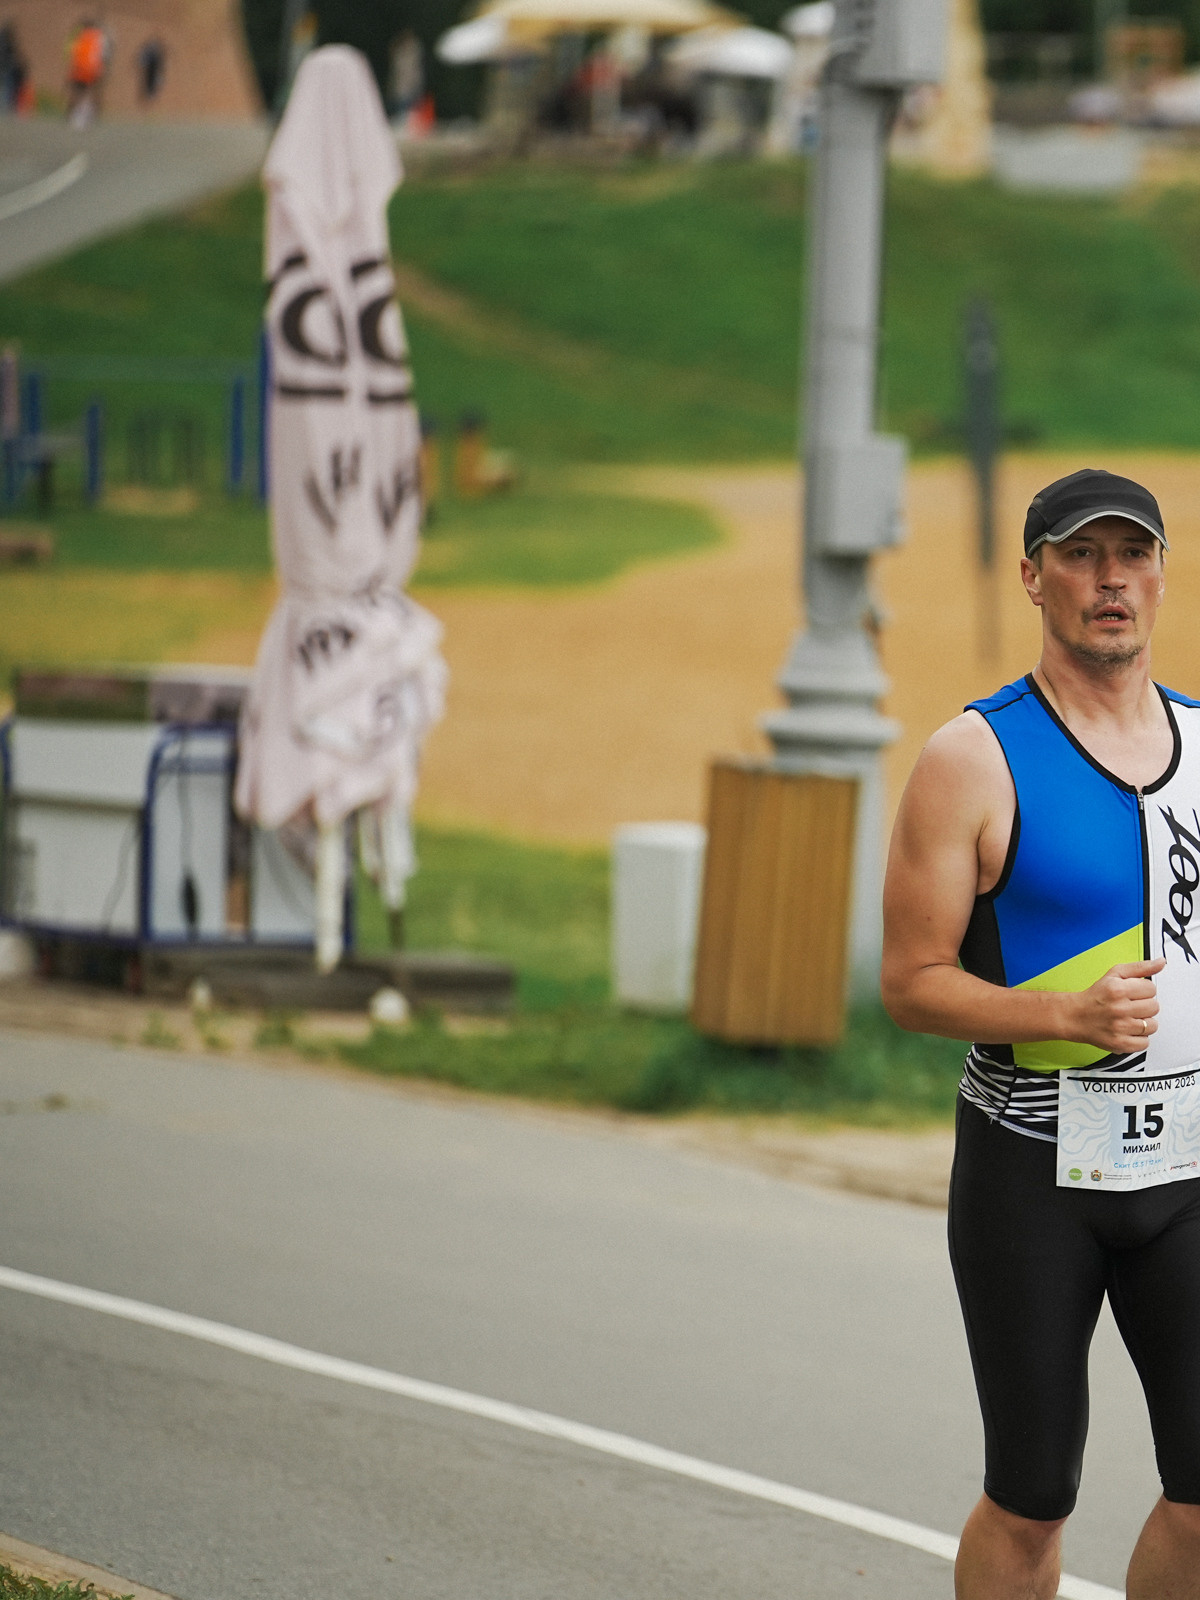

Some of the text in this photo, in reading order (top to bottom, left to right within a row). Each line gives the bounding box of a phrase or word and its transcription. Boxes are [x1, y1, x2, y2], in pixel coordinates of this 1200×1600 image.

[1082, 1075, 1196, 1094] VOLKHOVMAN 2023
[1122, 1102, 1164, 1140] 15
[1123, 1142, 1161, 1154] МИХАИЛ
